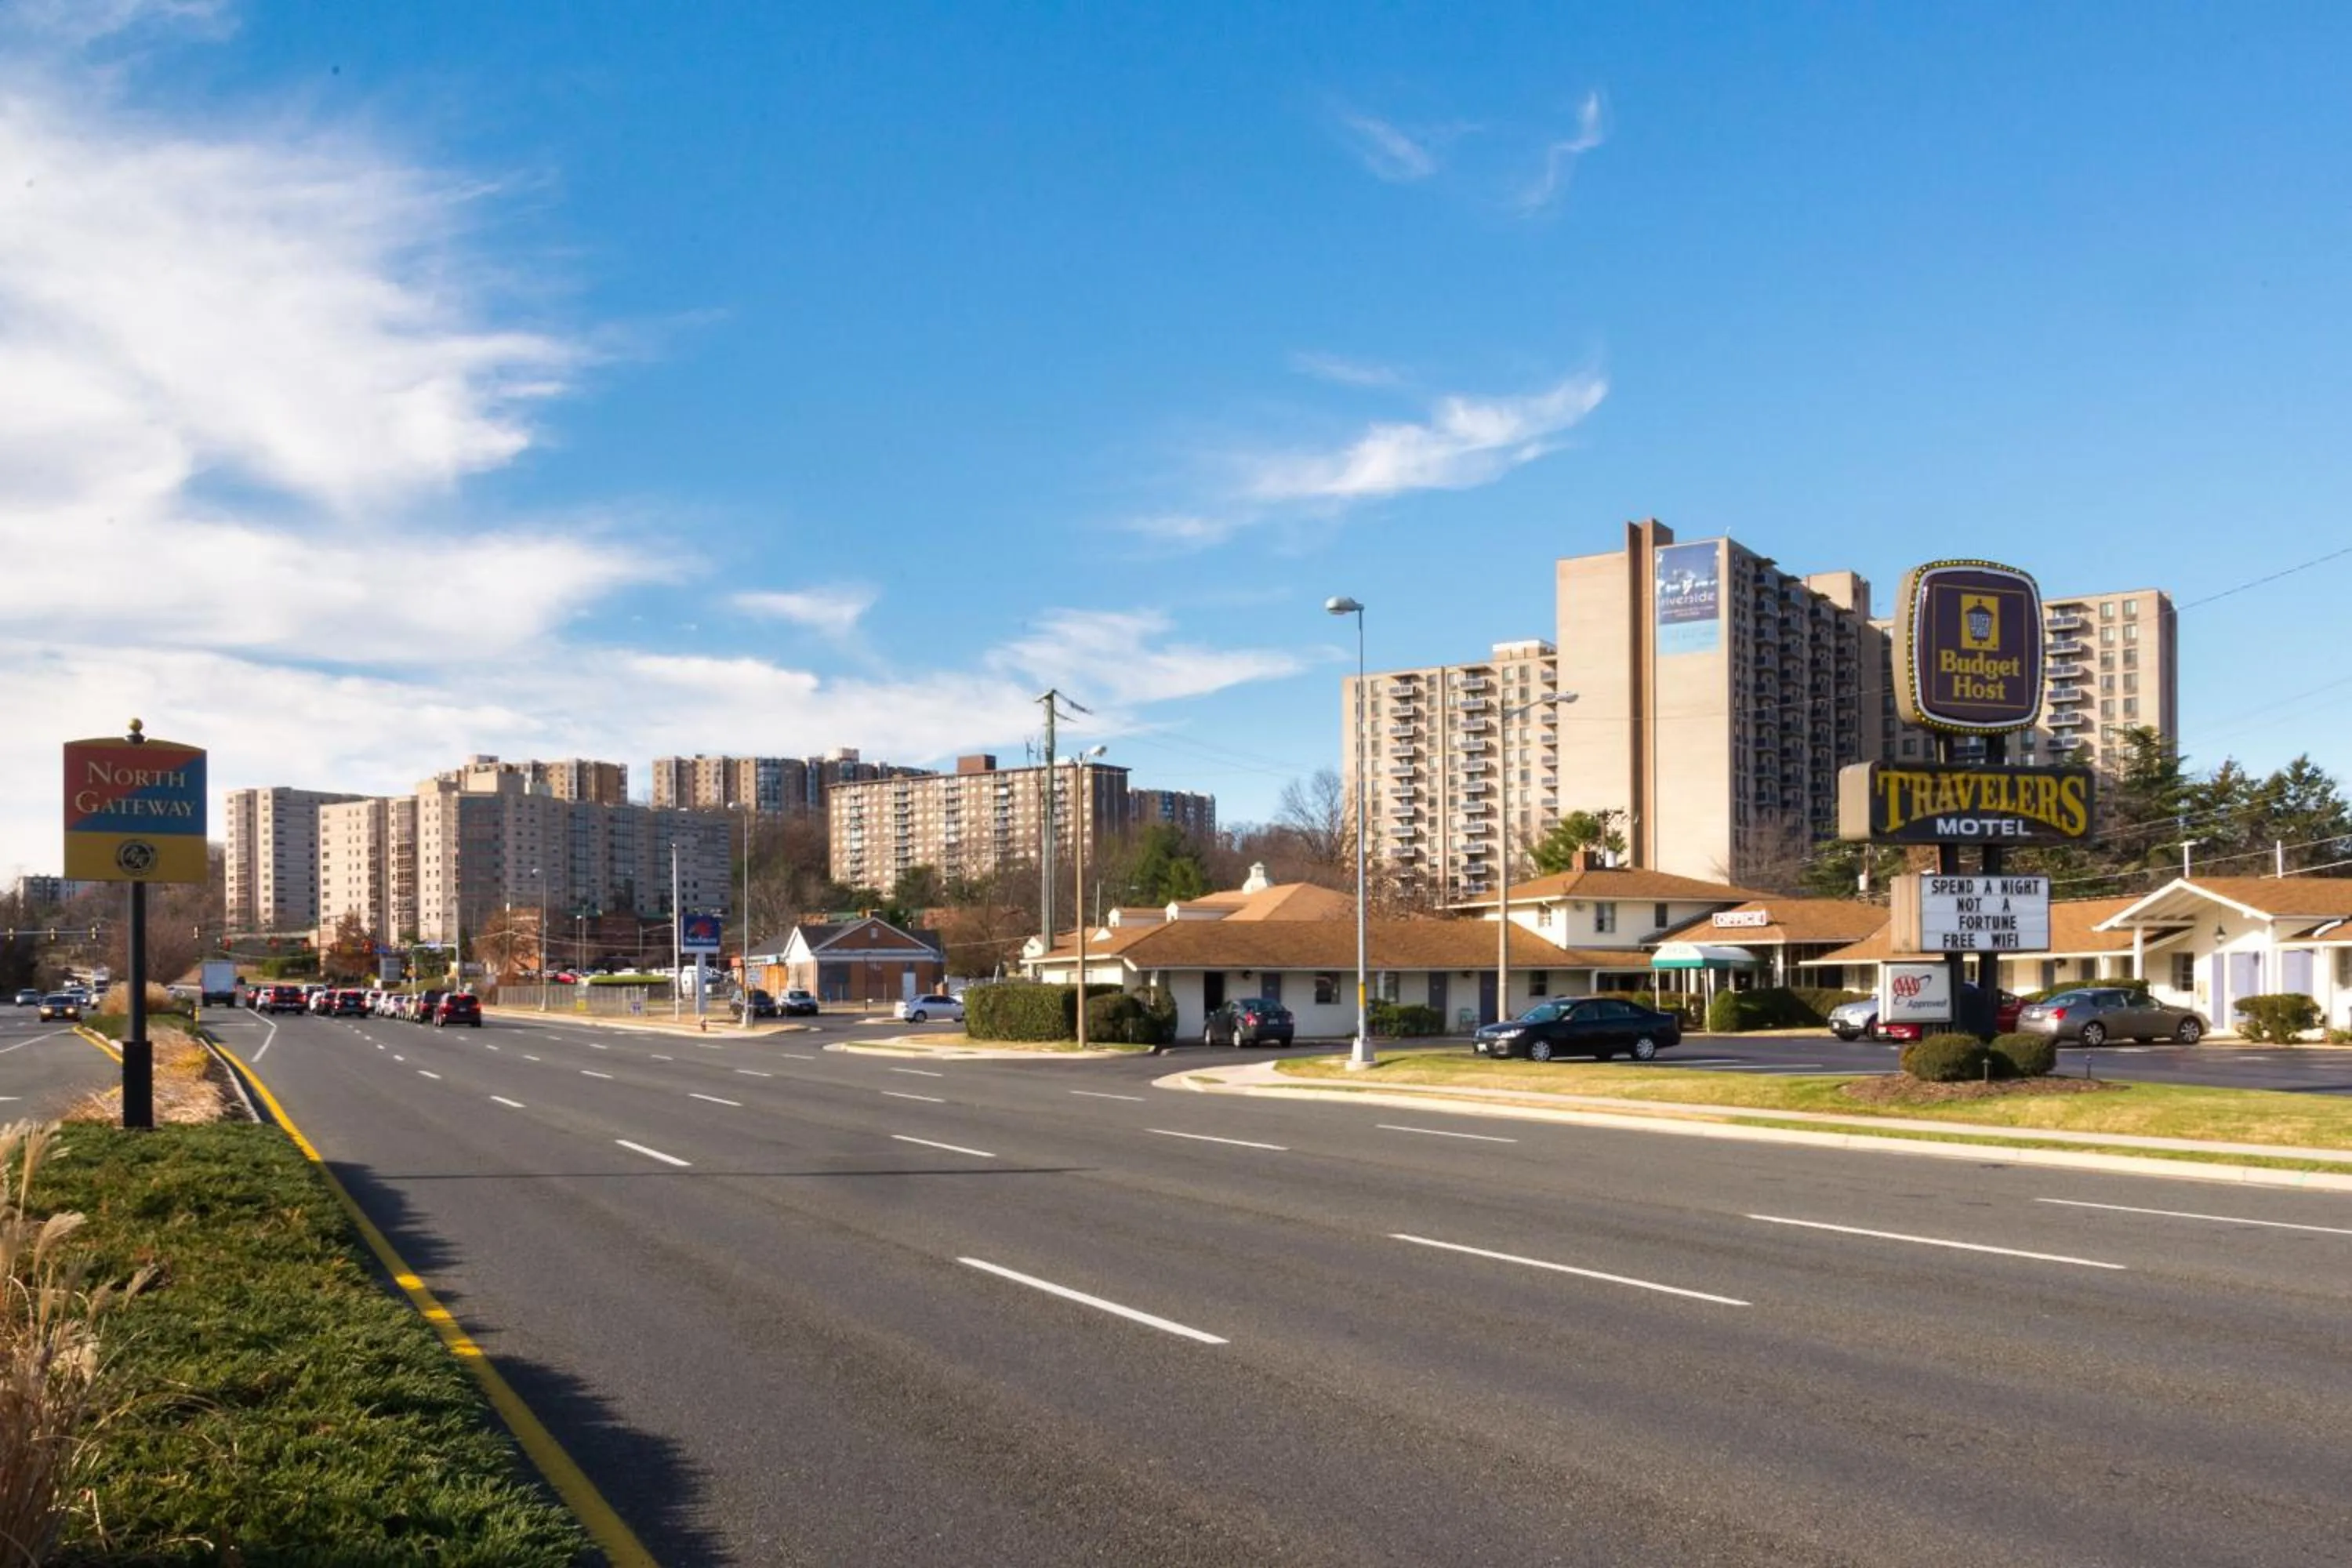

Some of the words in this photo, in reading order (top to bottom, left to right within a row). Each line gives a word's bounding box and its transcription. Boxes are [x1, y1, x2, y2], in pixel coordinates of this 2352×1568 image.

[1940, 649, 2020, 681] Budget
[1952, 676, 2006, 700] Host
[1877, 771, 2087, 837] TRAVELERS
[1936, 818, 2032, 836] MOTEL
[1931, 879, 1973, 895] SPEND
[1984, 880, 1992, 895] A
[2000, 880, 2040, 895] NIGHT
[1957, 898, 1982, 913] NOT
[2002, 898, 2011, 913] A
[1959, 915, 2017, 931] FORTUNE
[1944, 933, 1976, 949] FREE
[1991, 933, 2020, 948] WIFI
[1894, 977, 1919, 995] AAA
[1907, 1000, 1947, 1011] Approved
